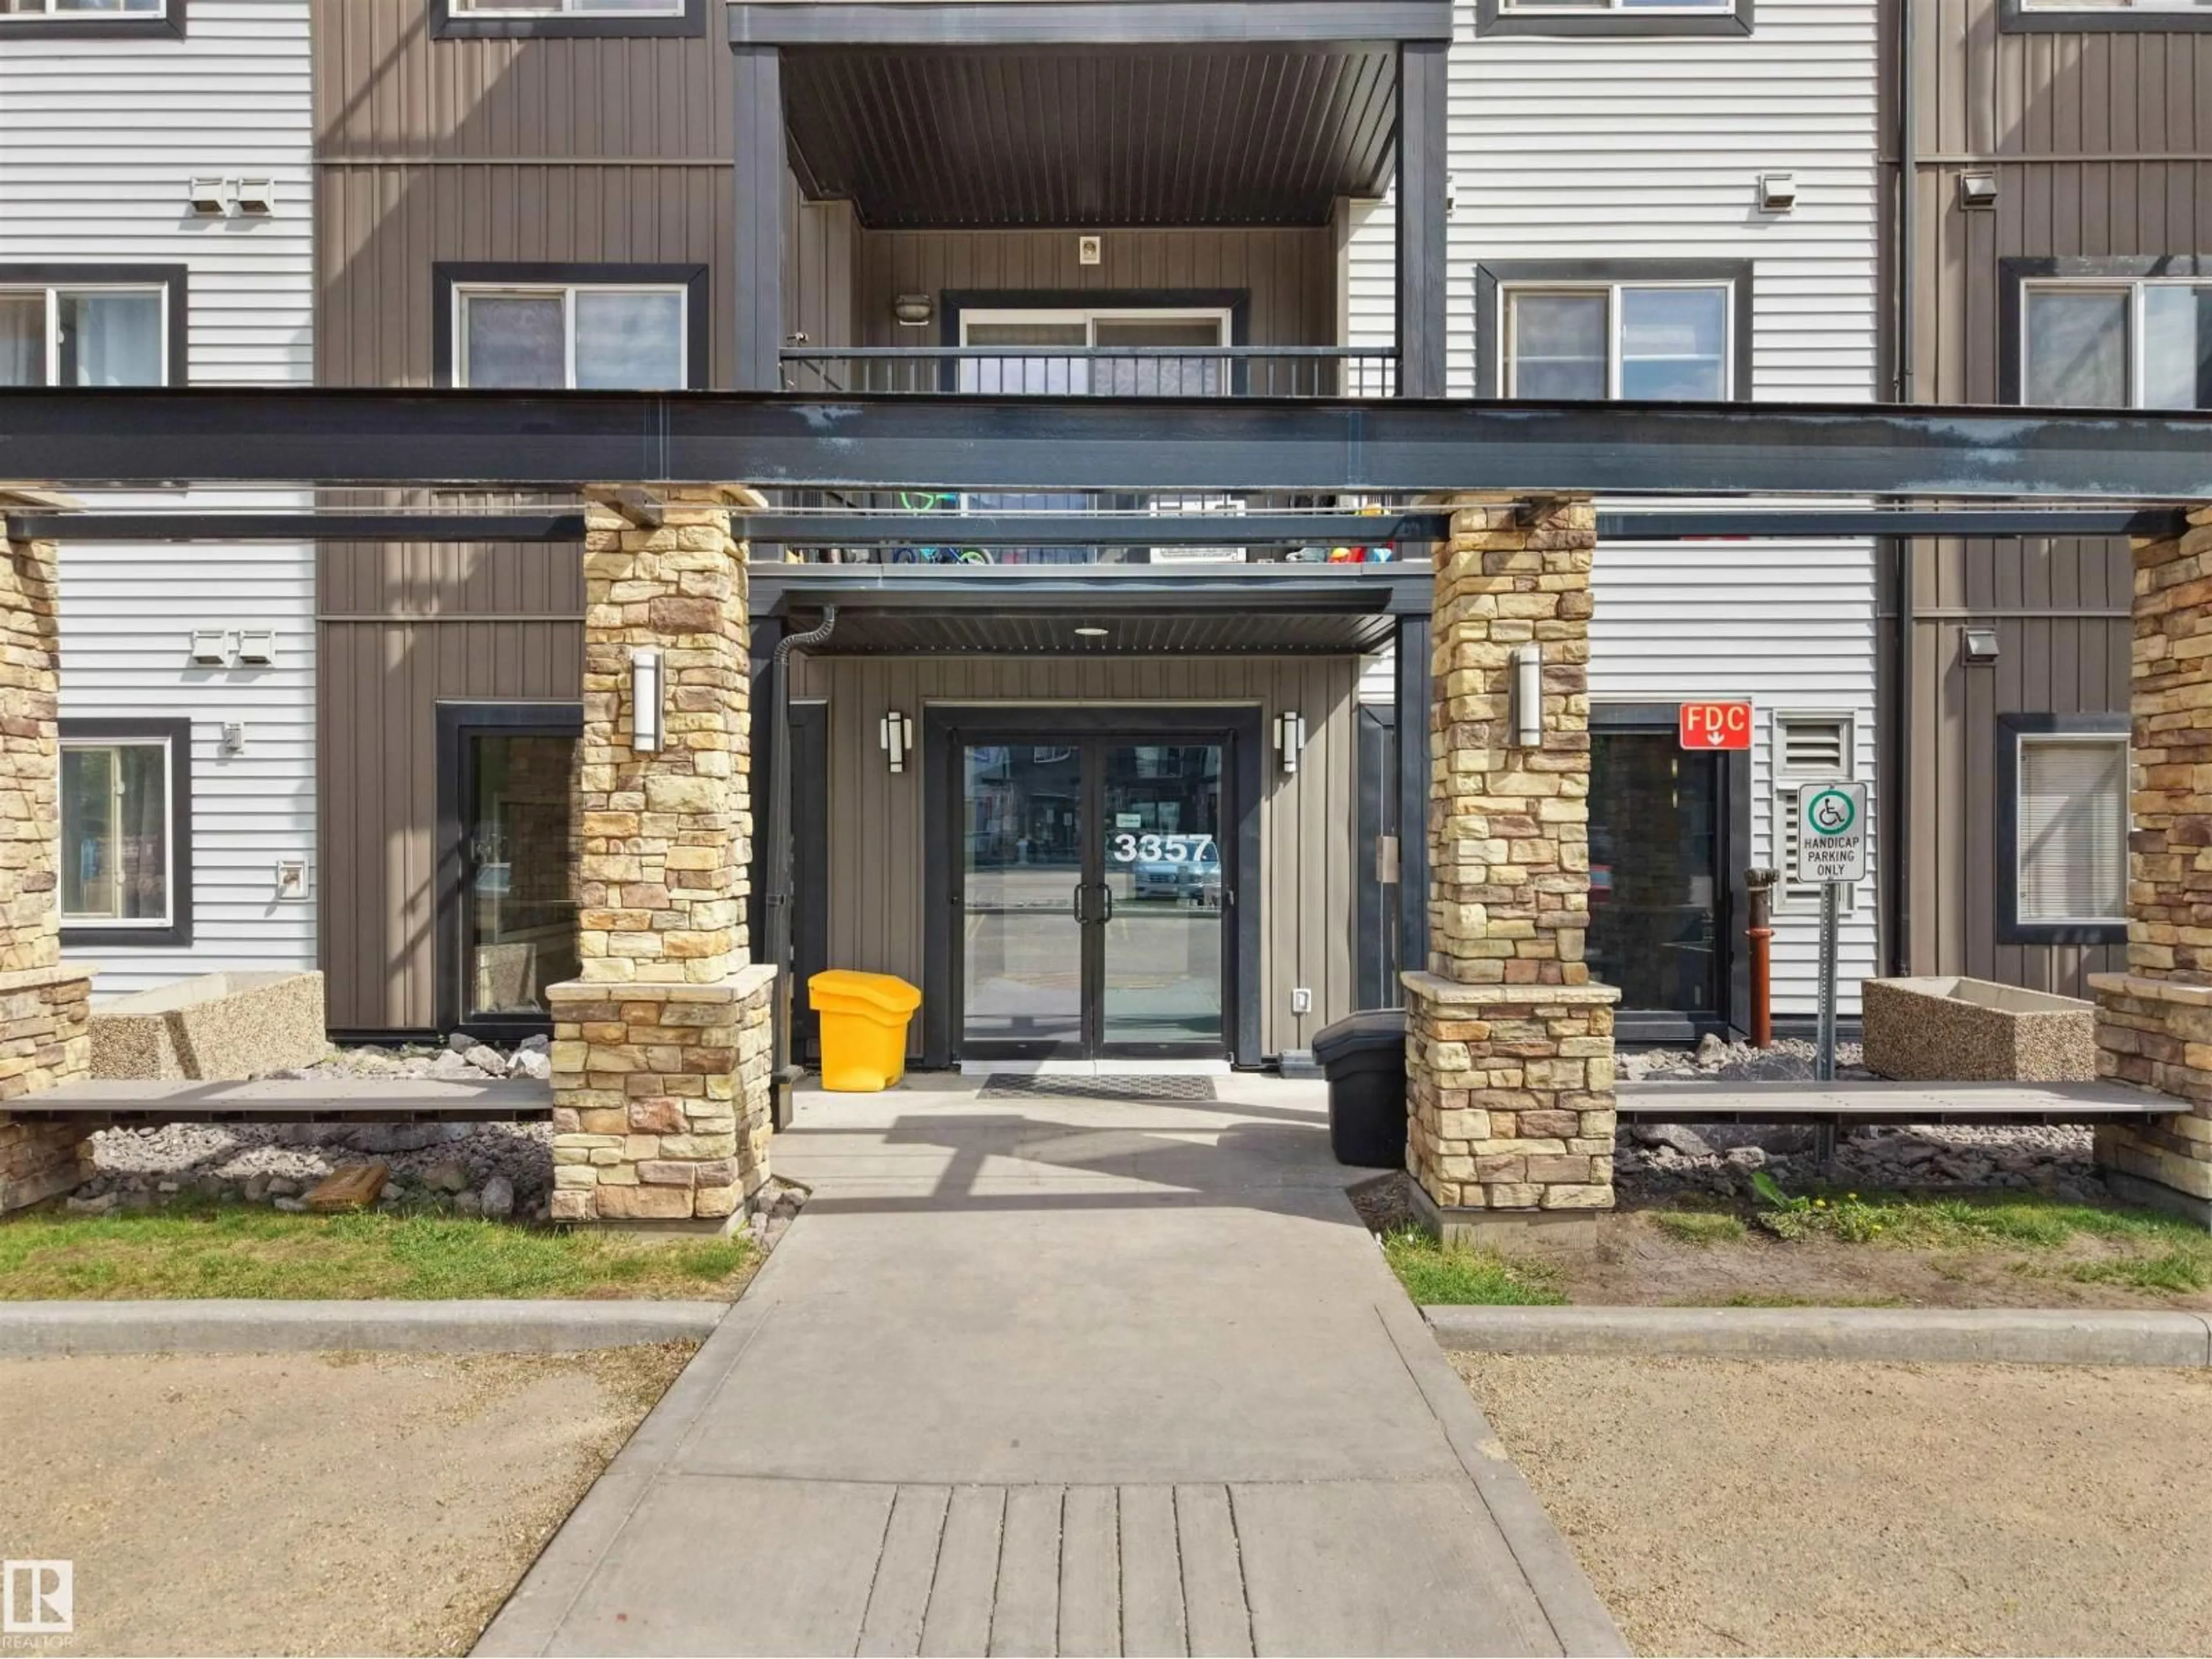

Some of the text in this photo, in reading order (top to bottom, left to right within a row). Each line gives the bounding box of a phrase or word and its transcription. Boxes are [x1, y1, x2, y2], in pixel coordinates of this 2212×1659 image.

[1688, 706, 1745, 731] FDC
[1114, 834, 1213, 862] 3357
[1804, 836, 1859, 849] HANDICAP
[1808, 850, 1855, 862] PARKING
[1817, 863, 1845, 876] ONLY
